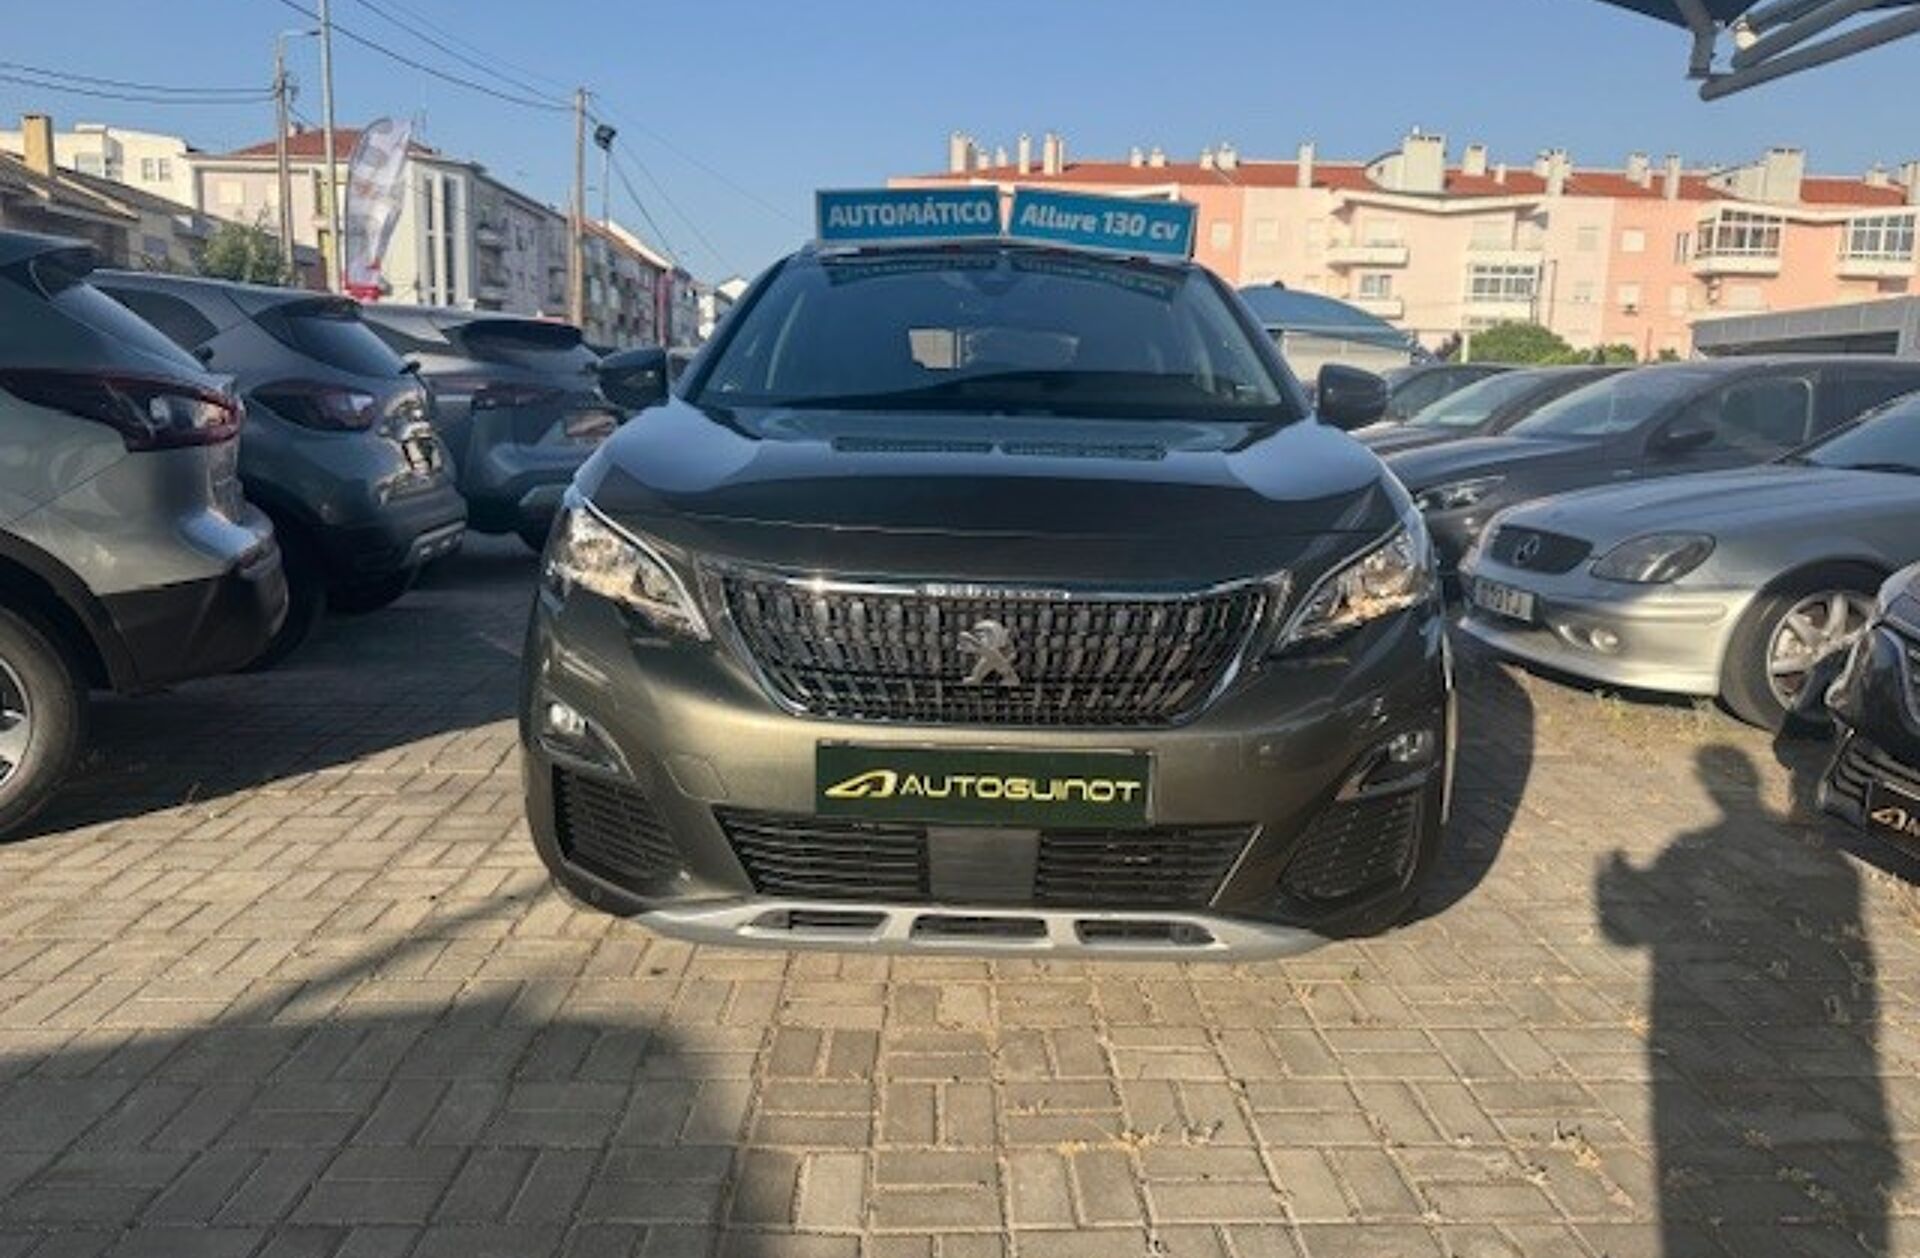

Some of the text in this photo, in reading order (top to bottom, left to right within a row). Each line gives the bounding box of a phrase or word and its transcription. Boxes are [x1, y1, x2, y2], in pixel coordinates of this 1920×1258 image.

[828, 197, 991, 228] AUTOMÁTICO
[1020, 203, 1181, 241] Allure 130 cv
[900, 775, 1141, 801] AUTOGUINOT
